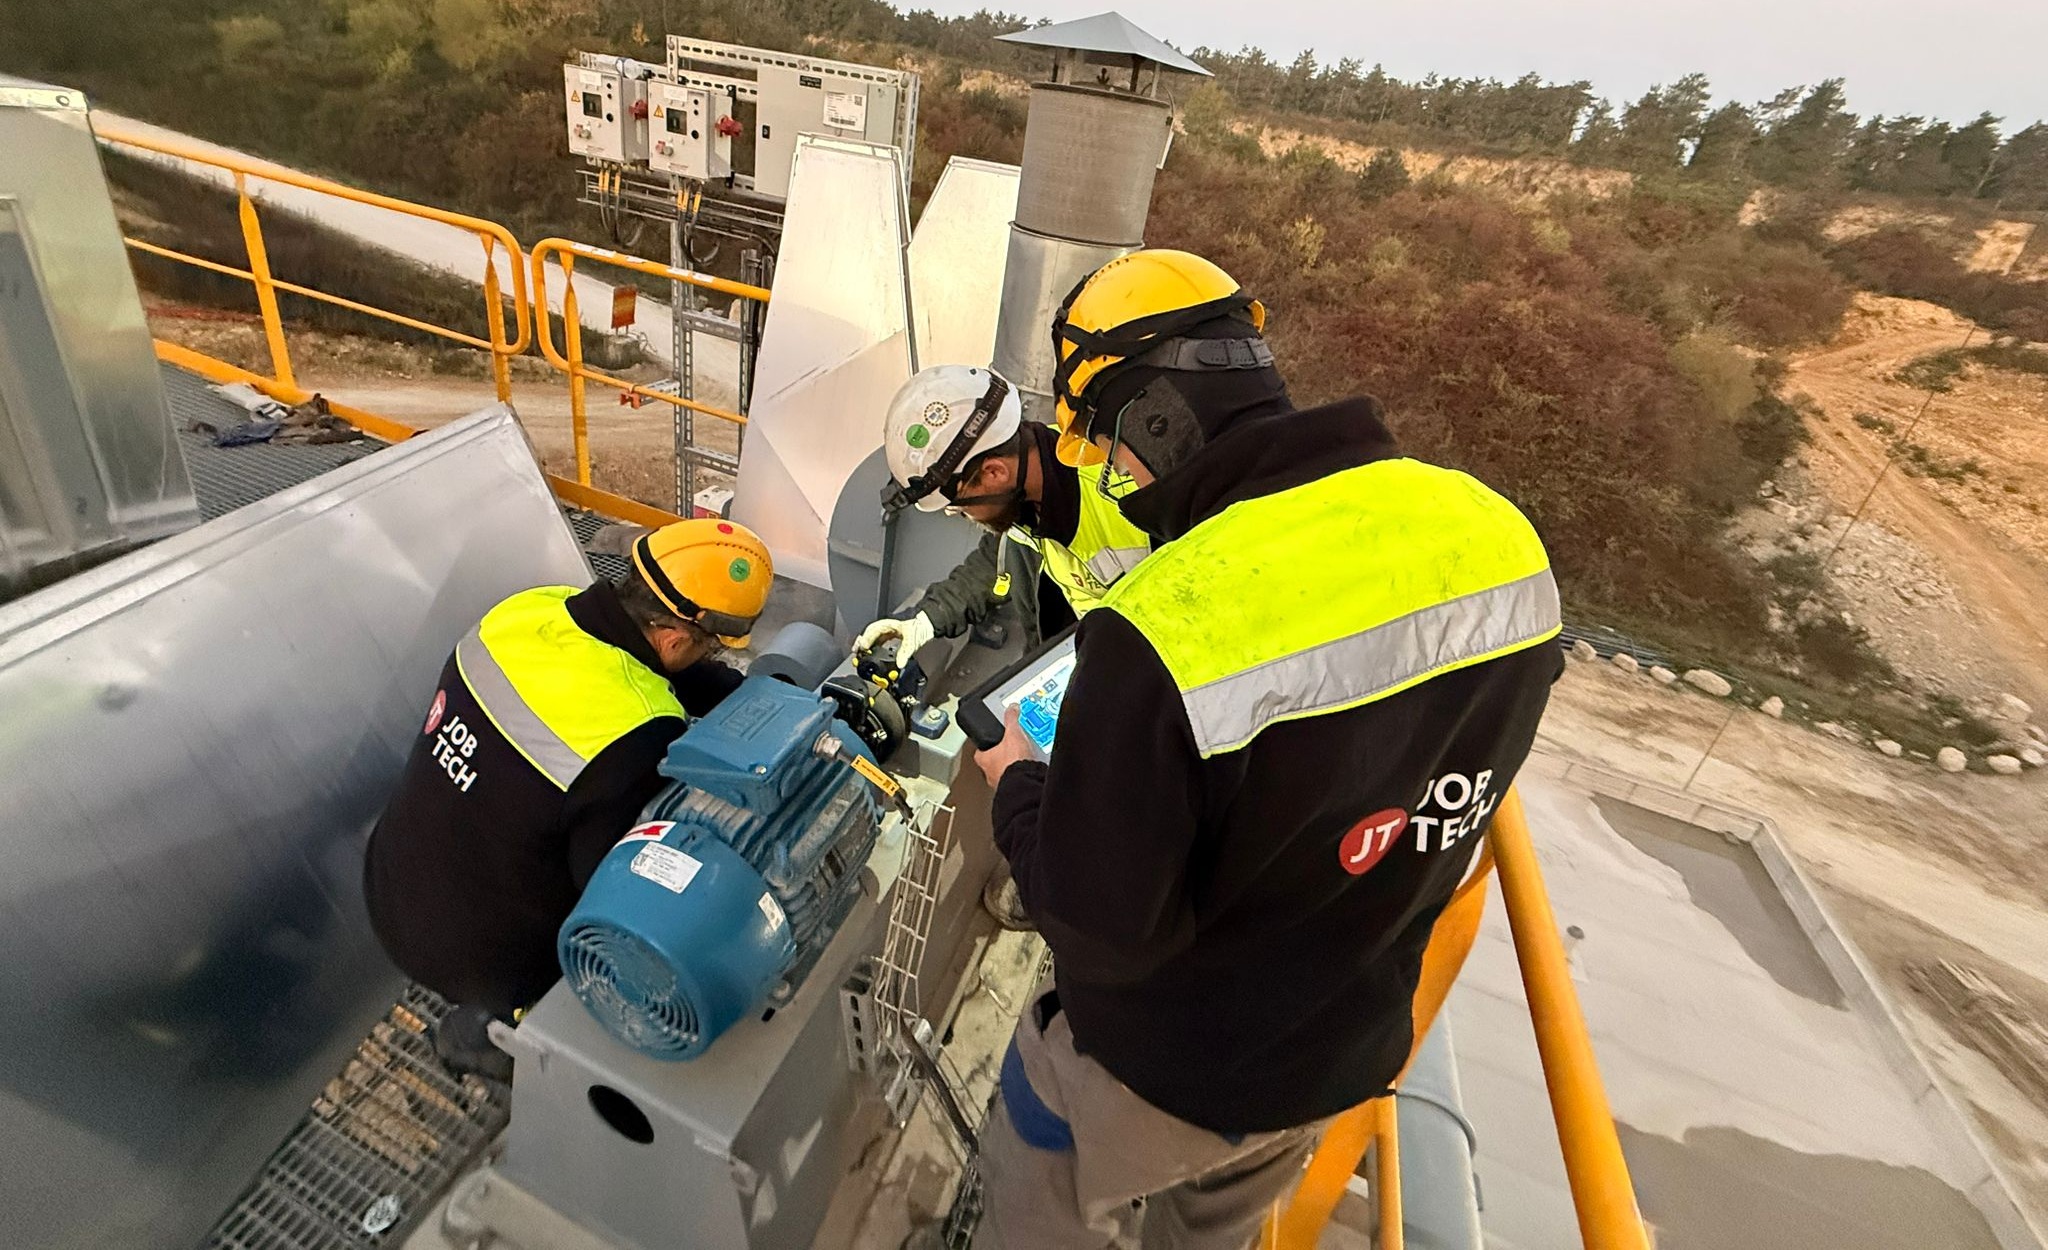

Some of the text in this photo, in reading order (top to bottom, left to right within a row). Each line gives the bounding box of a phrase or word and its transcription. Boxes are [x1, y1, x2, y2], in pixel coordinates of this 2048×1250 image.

[442, 715, 478, 758] JOB
[431, 733, 478, 793] TECH
[1416, 769, 1493, 811] JOB
[1350, 818, 1401, 864] JT
[1410, 792, 1497, 853] TECH
